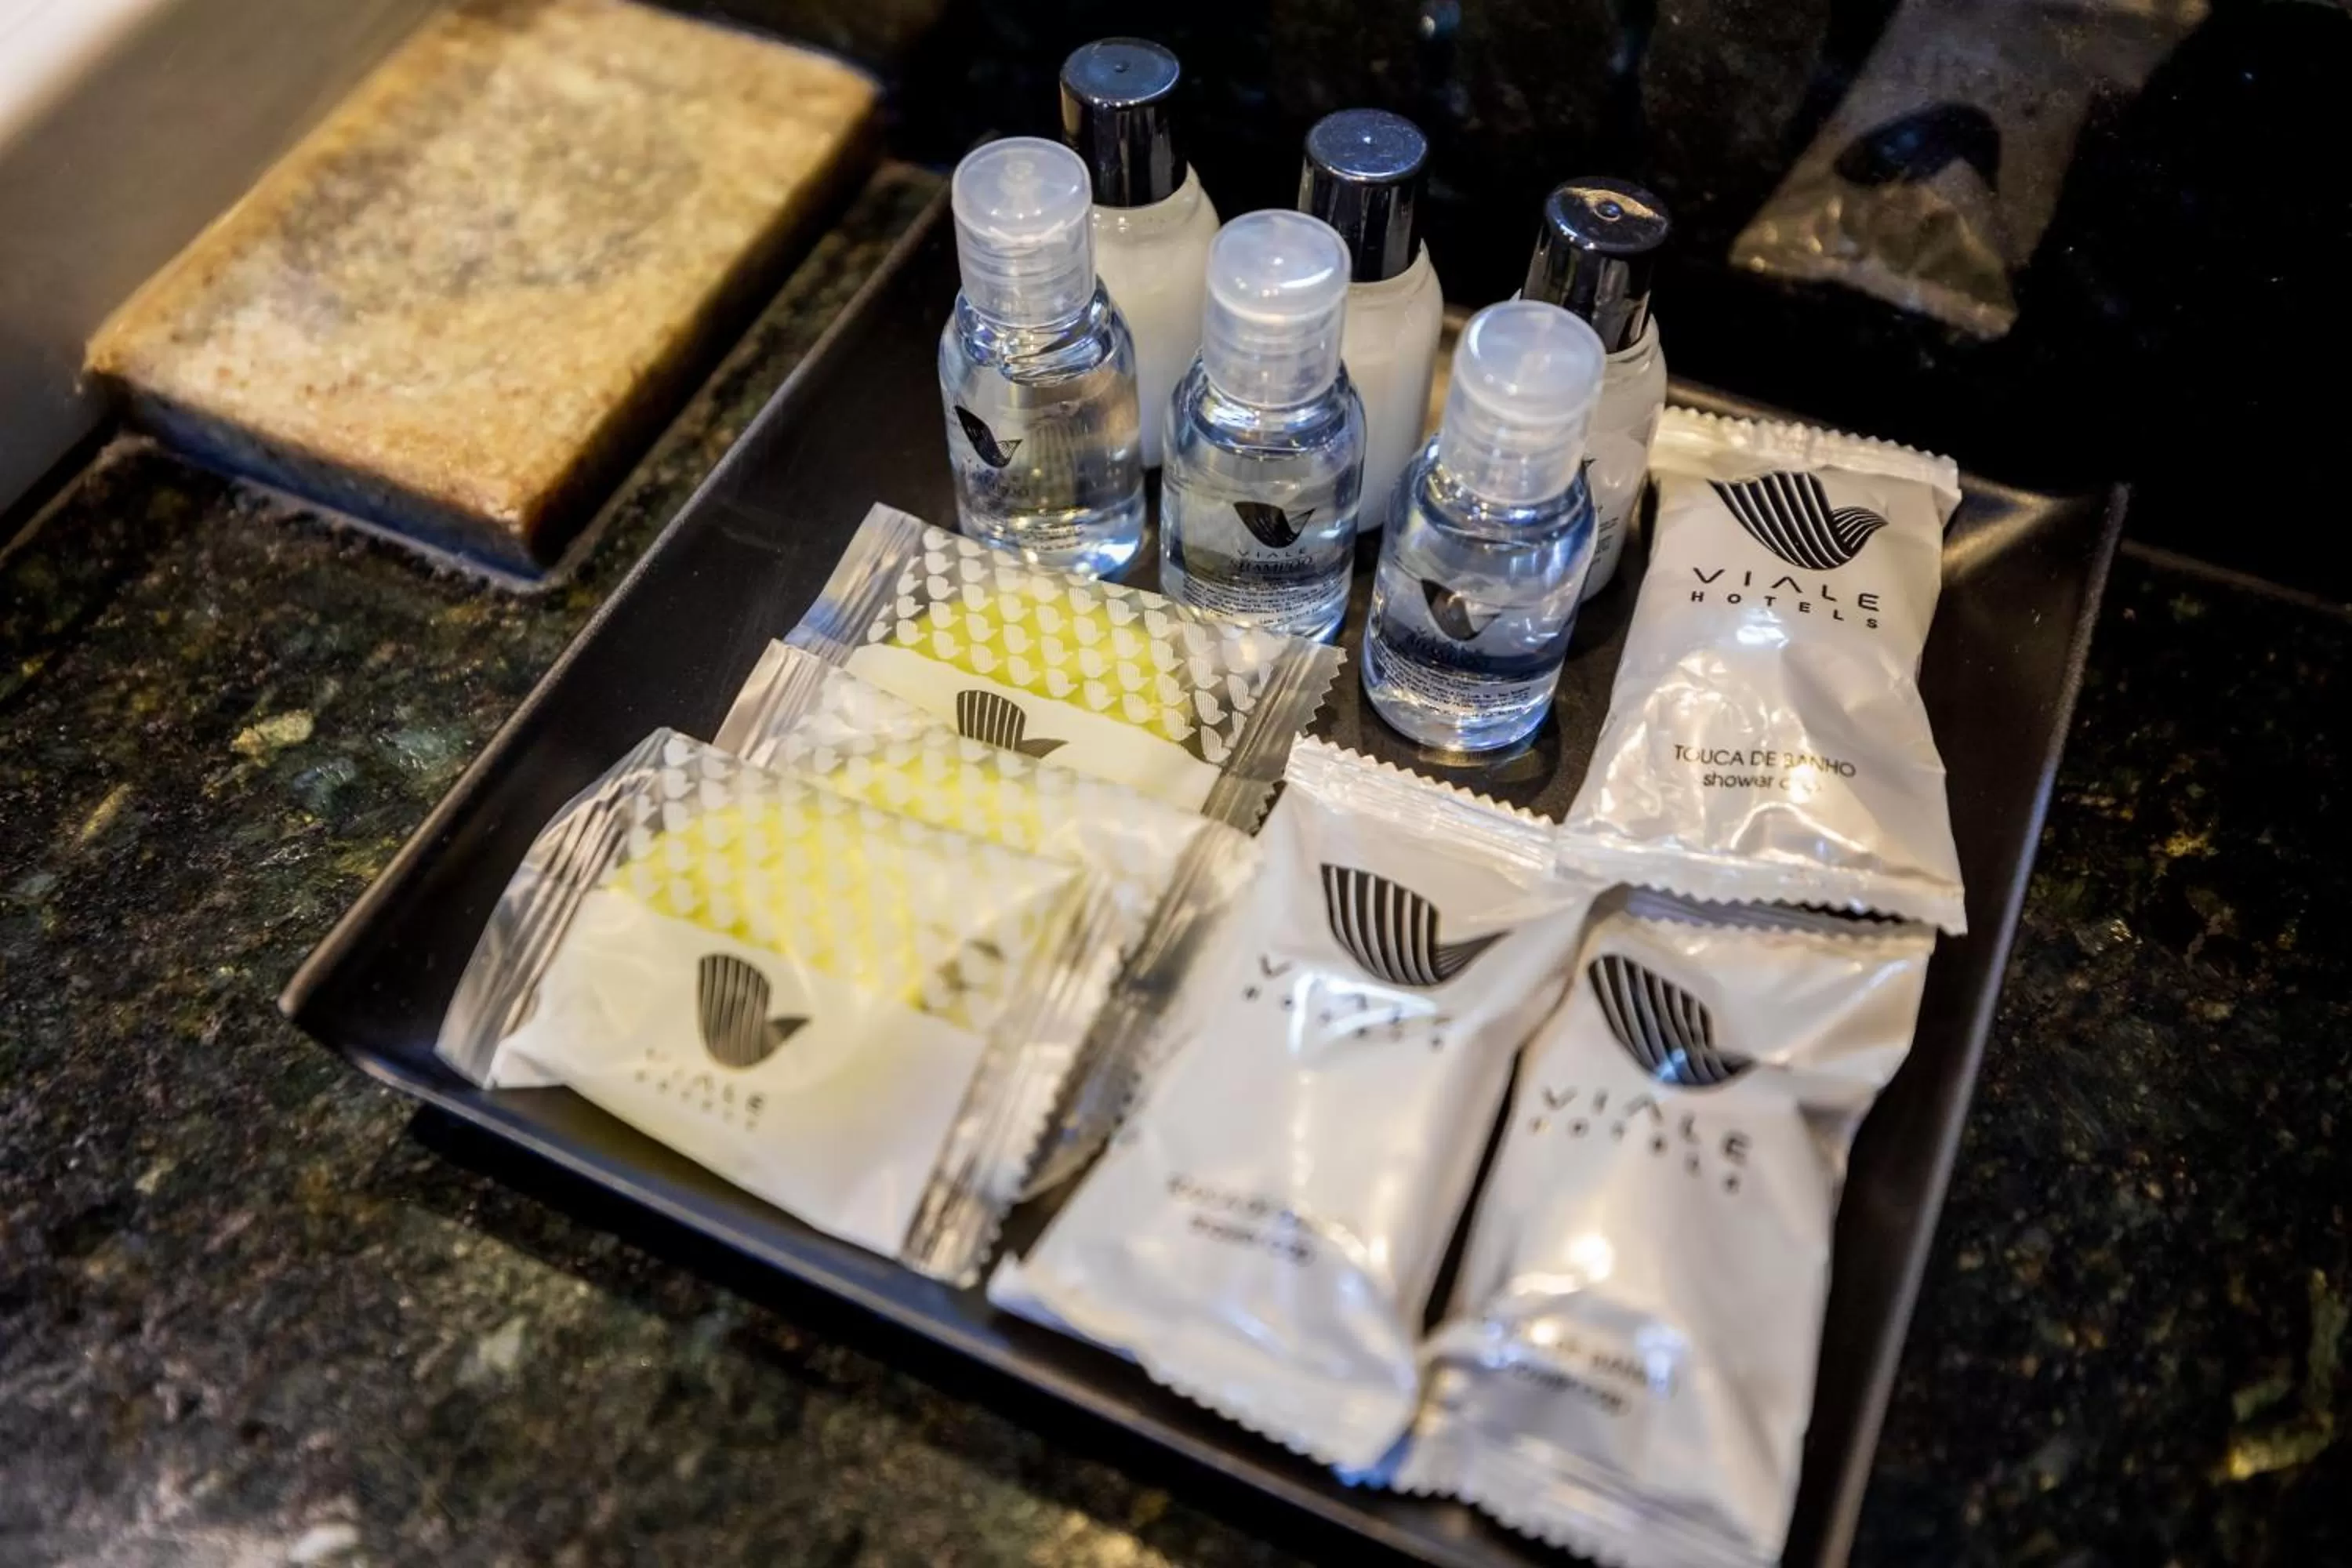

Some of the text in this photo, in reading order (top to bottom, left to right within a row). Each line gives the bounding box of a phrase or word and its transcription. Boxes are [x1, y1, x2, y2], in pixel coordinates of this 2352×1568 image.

[1693, 567, 1879, 612] VIALE
[1691, 590, 1878, 629] HOTELS
[1674, 744, 1744, 767] TOUCA
[1750, 750, 1777, 768] DE
[1702, 771, 1775, 791] shower
